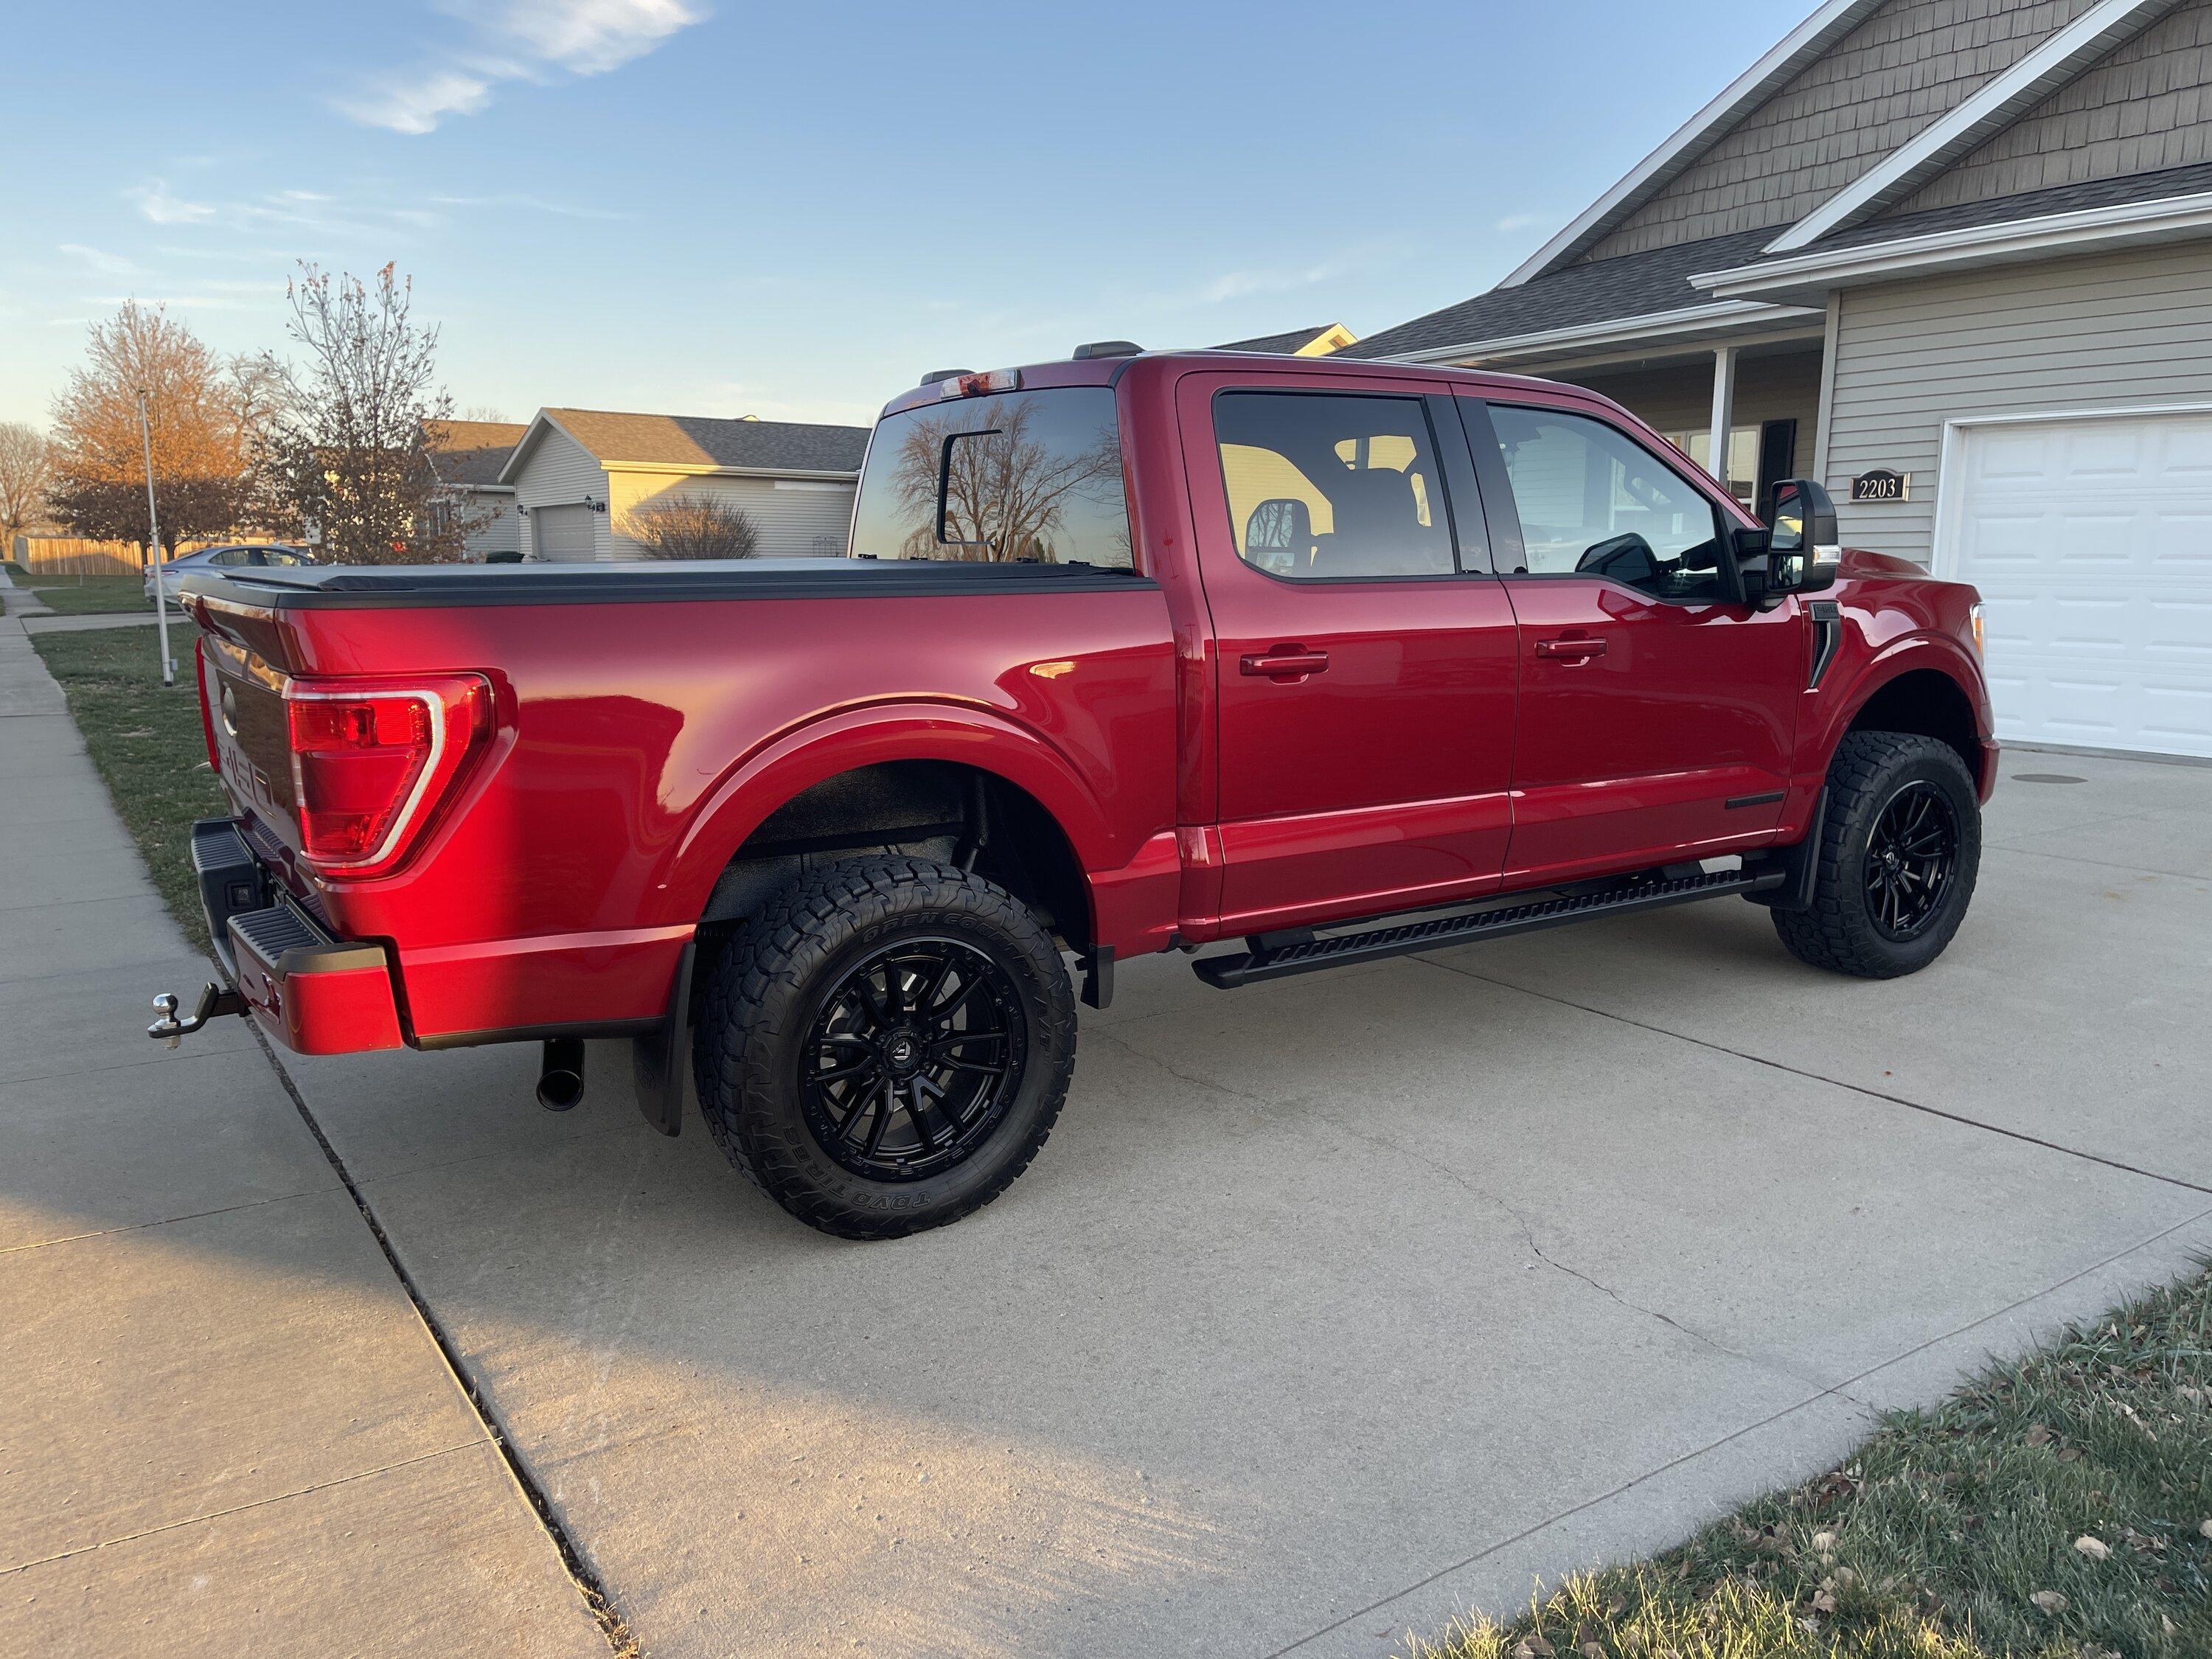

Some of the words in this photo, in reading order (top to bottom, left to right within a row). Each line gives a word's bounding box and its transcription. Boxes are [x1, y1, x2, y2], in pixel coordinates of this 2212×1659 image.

[1859, 479, 1896, 498] 2203
[862, 911, 939, 944] OPEN
[782, 1125, 851, 1199] TIRES
[850, 1191, 931, 1211] TOYO
